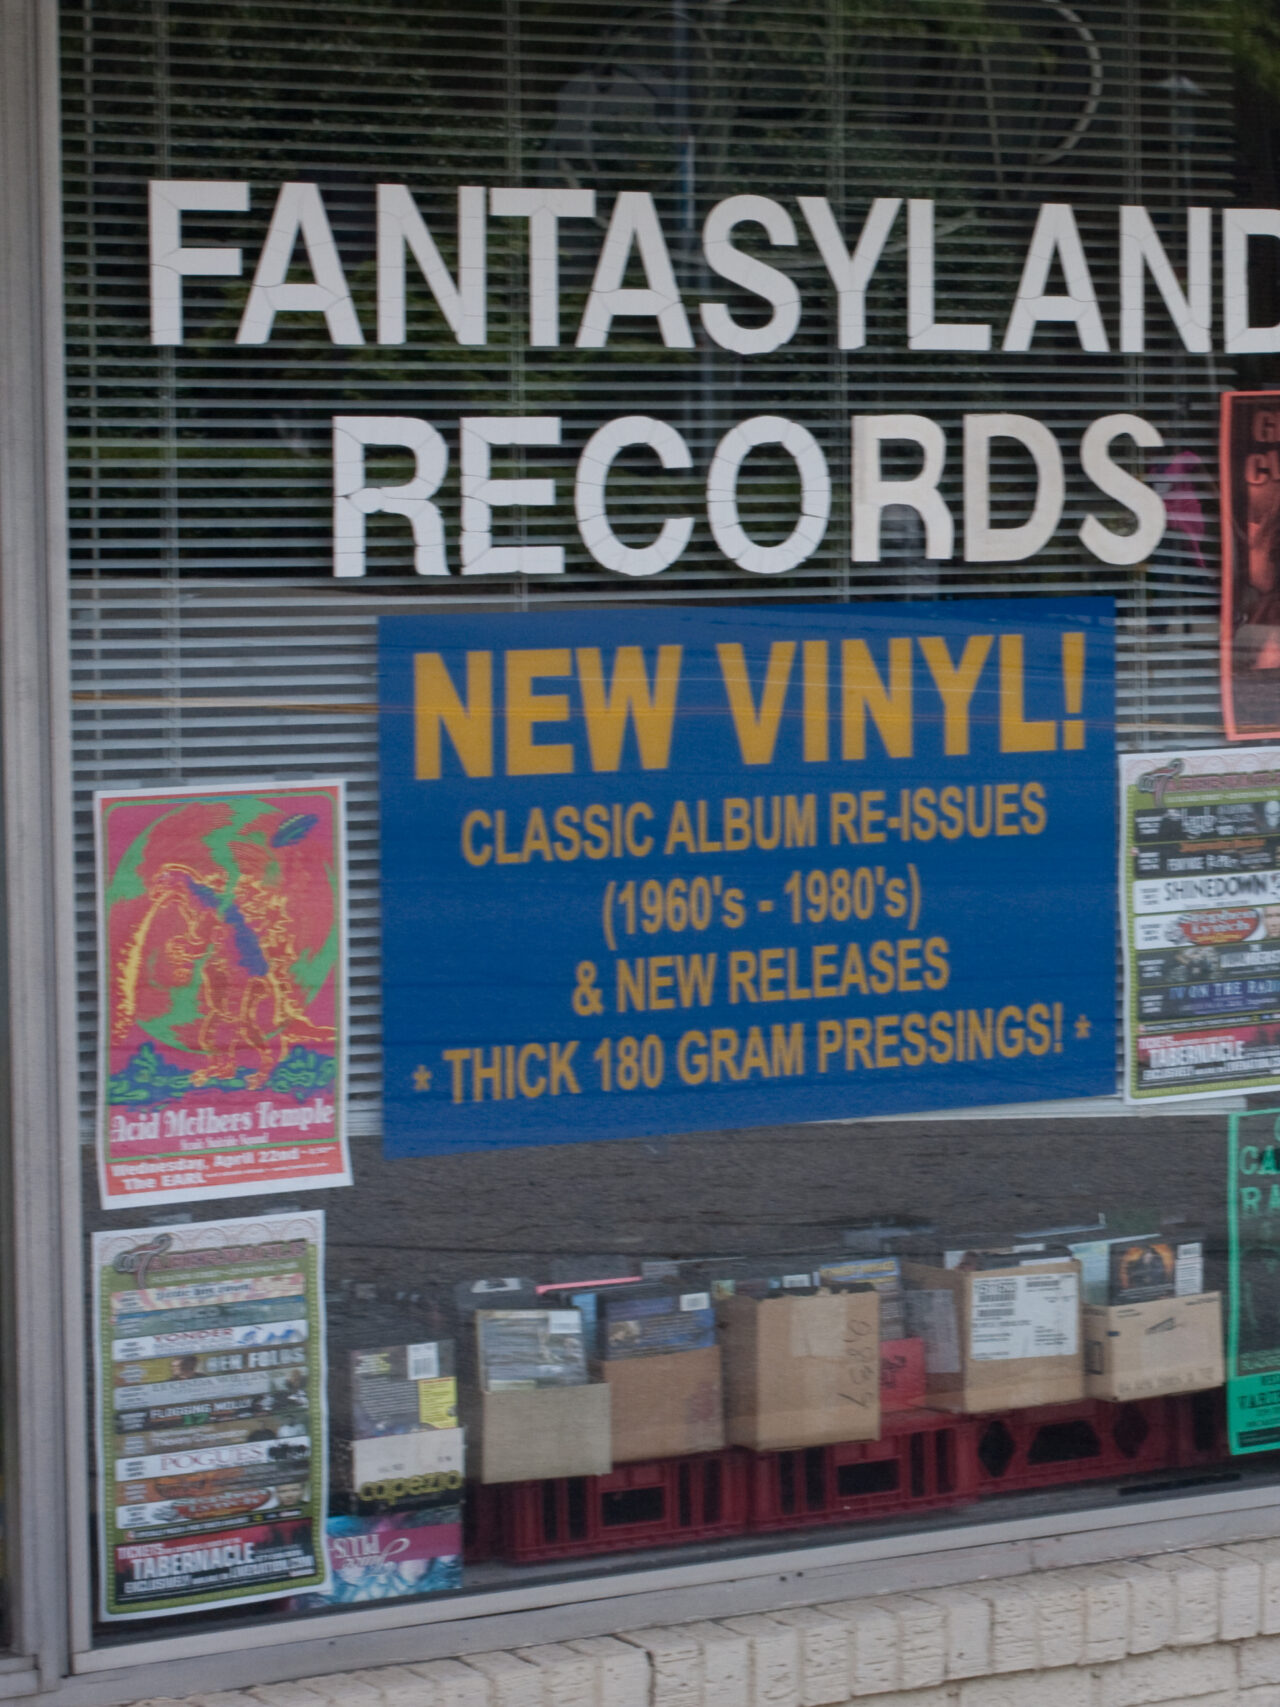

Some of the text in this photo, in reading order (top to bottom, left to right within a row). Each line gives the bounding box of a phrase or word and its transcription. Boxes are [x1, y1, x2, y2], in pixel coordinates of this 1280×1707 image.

[332, 413, 1168, 577] RECORDS
[413, 632, 1085, 780] NEW VINYL!
[461, 782, 1047, 866] CLASSIC ALBUM RE-ISSUES
[603, 875, 746, 951] (1960's
[784, 863, 922, 931] 1980's)
[1164, 873, 1268, 902] SHINEDOWN
[571, 936, 950, 1016] & NEW RELEASES
[442, 1002, 1064, 1104] THICK 180 GRAM PRESSINGS!
[110, 1098, 335, 1143] Acid Mothers Temple
[214, 1153, 255, 1168] April
[258, 1148, 300, 1163] 22nd
[122, 1172, 206, 1191] The EARL
[153, 1326, 234, 1343] YONDER
[160, 1446, 266, 1471] POGUES
[131, 1542, 256, 1580] TABERNACLE
